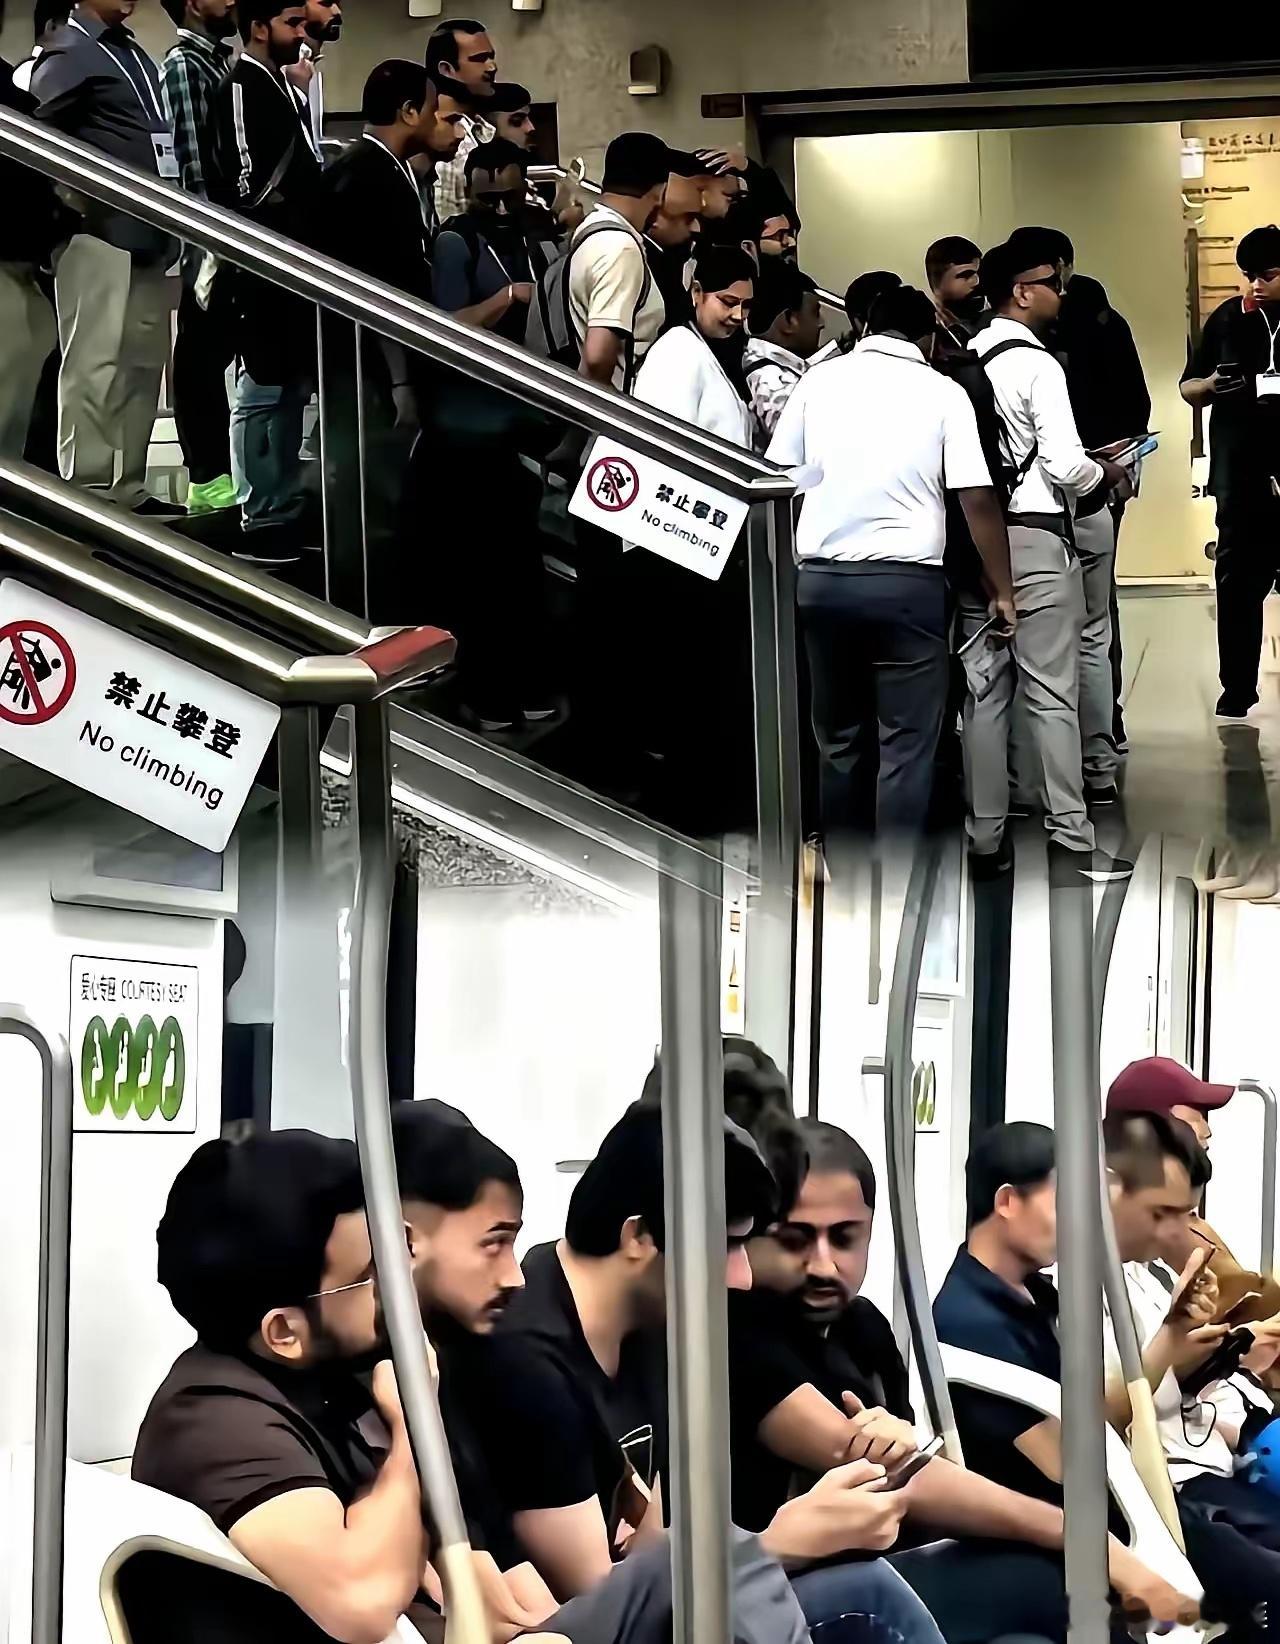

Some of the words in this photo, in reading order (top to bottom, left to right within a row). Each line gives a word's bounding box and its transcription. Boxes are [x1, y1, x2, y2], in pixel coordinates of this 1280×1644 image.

[641, 509, 660, 527] No
[663, 522, 720, 556] climbing
[105, 671, 241, 759] 禁止攀登
[79, 720, 114, 752] No
[120, 746, 224, 810] climbing
